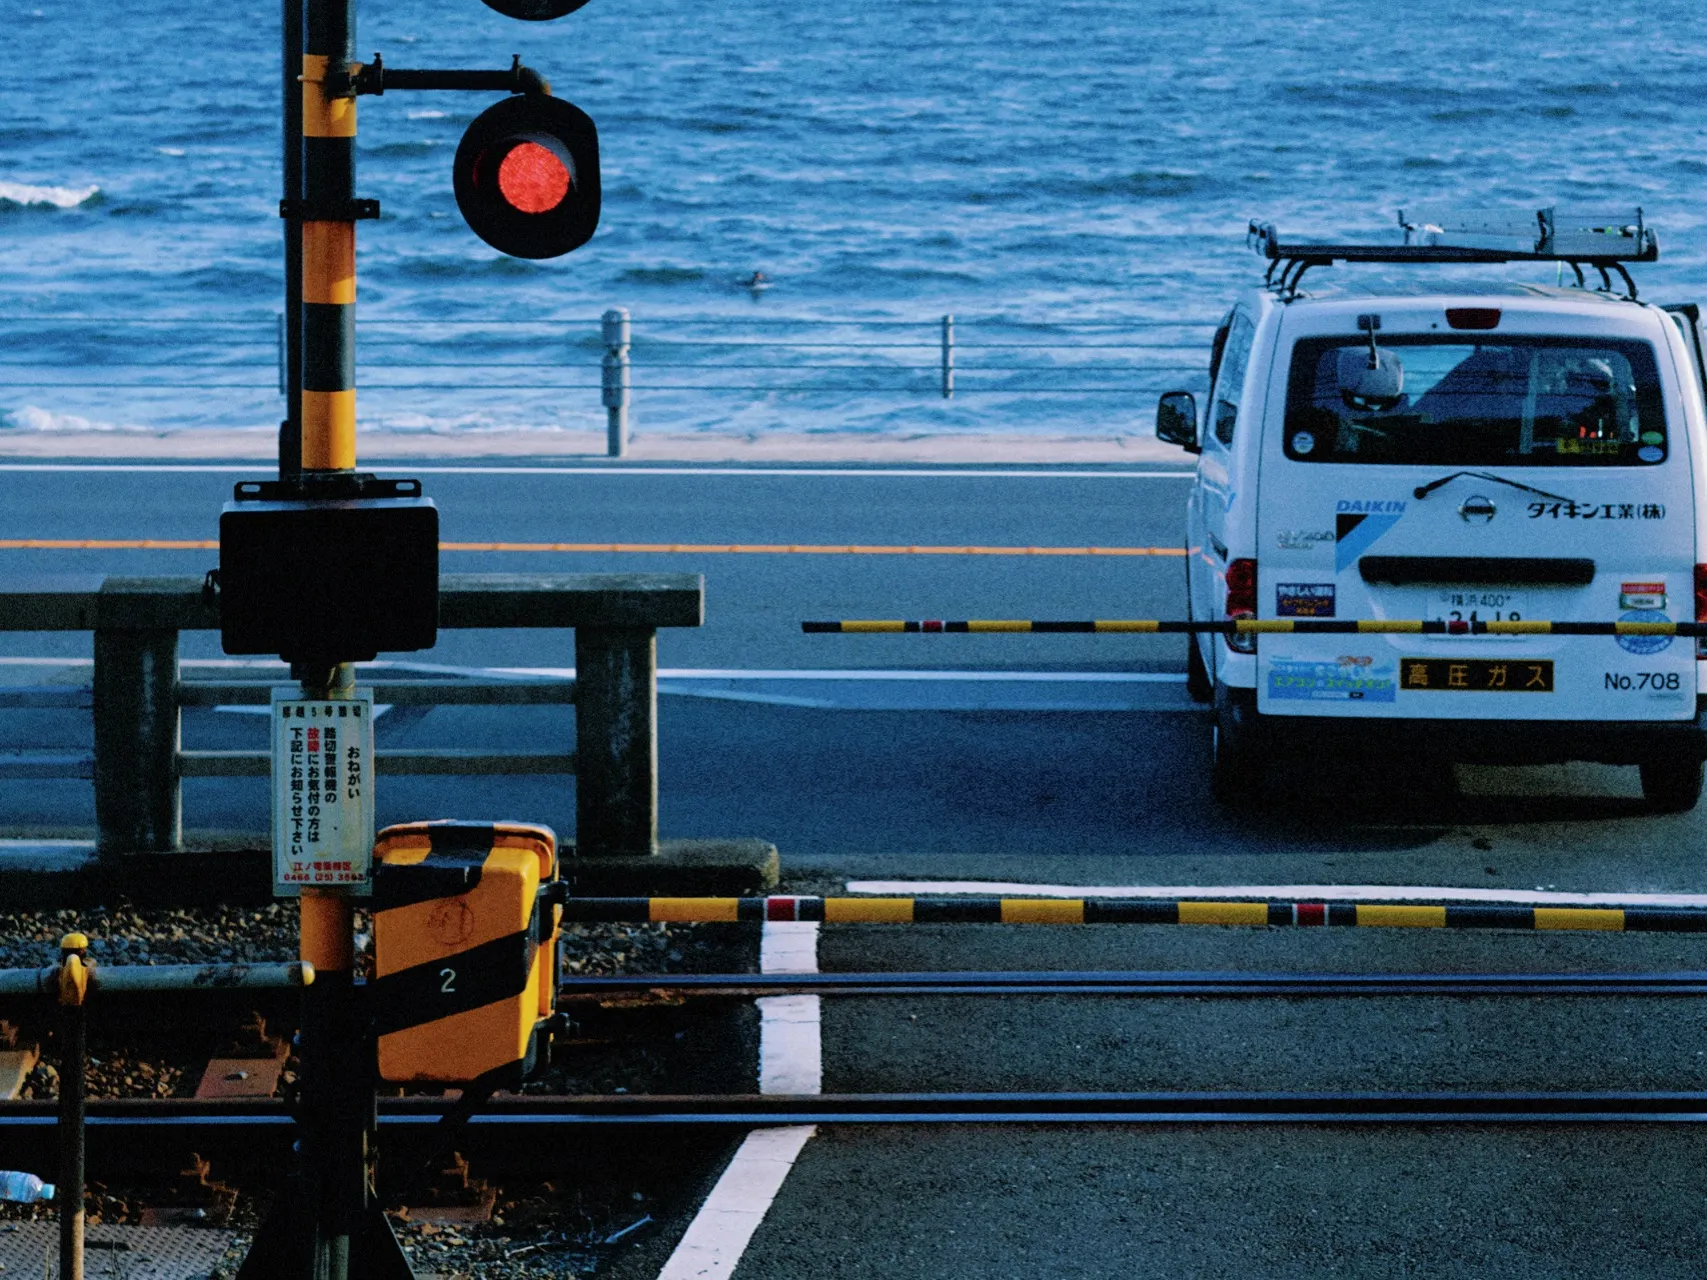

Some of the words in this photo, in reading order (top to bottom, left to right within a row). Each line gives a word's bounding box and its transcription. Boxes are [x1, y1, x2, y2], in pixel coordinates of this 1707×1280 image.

[1336, 500, 1407, 512] DAIKIN
[1527, 503, 1666, 519] ダイキン工業(株)
[1408, 664, 1545, 687] 高圧ガス
[1605, 672, 1680, 690] No.708
[307, 727, 320, 842] 故障にお気付の方は
[347, 746, 360, 799] おねがい
[290, 727, 303, 855] 下記にお知らせ下さい
[440, 968, 456, 993] 2
